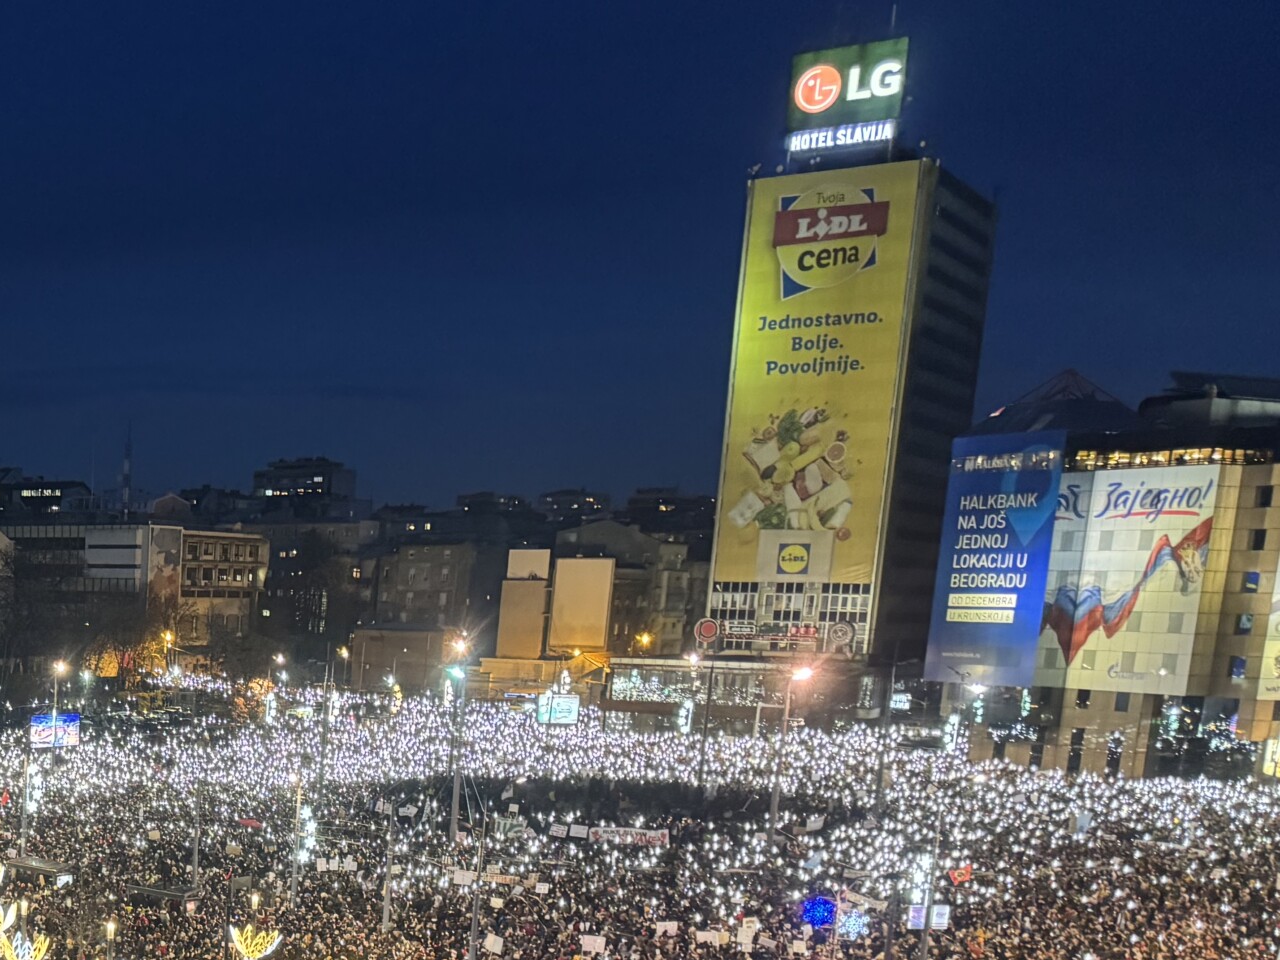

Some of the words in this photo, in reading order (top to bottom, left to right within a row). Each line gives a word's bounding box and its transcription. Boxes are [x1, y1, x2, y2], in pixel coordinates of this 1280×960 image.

[846, 60, 902, 101] LG
[790, 132, 834, 151] HOTEL
[836, 123, 893, 145] SLAVIJA
[816, 192, 845, 205] Tvoja
[797, 246, 860, 271] cena
[758, 311, 883, 332] Jednostavno.
[791, 333, 844, 353] Bolje.
[766, 355, 865, 376] Povoljnije.
[960, 493, 1038, 510] HALKBANK
[957, 515, 977, 529] NA
[979, 510, 1006, 529] JOŠ
[954, 533, 1009, 549] JEDNOJ
[952, 553, 1013, 569] LOKACIJI
[1016, 553, 1028, 568] U
[950, 573, 1027, 588] BEOGRADU
[951, 596, 963, 605] OD
[964, 596, 1013, 605] DECEMBRA
[949, 612, 956, 620] U
[956, 612, 1004, 621] KRUNSKOJ
